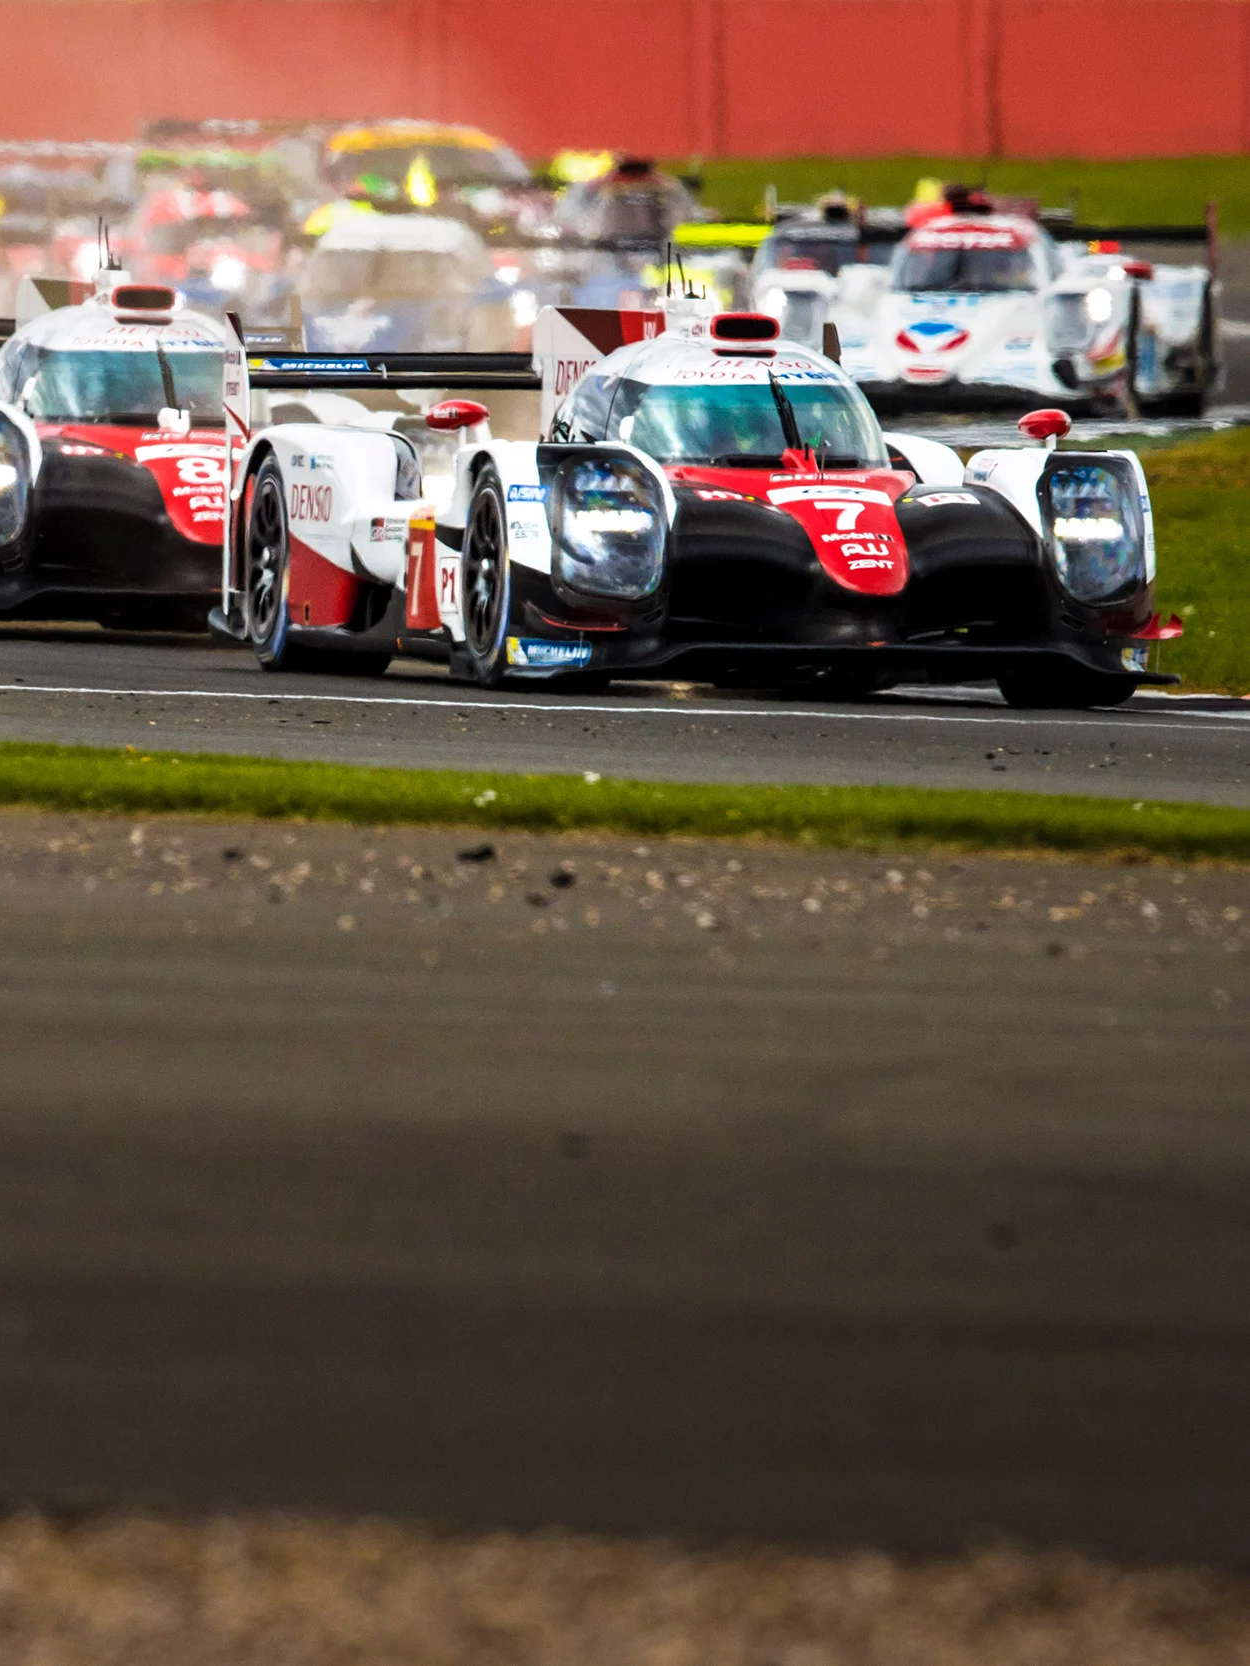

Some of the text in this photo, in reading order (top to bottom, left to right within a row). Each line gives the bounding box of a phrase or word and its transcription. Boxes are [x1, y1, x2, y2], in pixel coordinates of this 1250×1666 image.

[71, 337, 145, 348] TOYOTA
[280, 361, 364, 370] MICHELIN
[710, 359, 813, 370] DENSO
[554, 360, 597, 395] DEN
[673, 370, 757, 381] TOYOTA
[176, 457, 228, 484] 8
[508, 486, 547, 501] AISIN
[291, 483, 333, 523] DENSO
[813, 502, 866, 530] 7
[821, 532, 876, 543] Mobil
[847, 558, 895, 571] ZENT
[410, 541, 424, 616] 7
[441, 567, 456, 604] P1
[527, 644, 589, 659] MICHELIN
